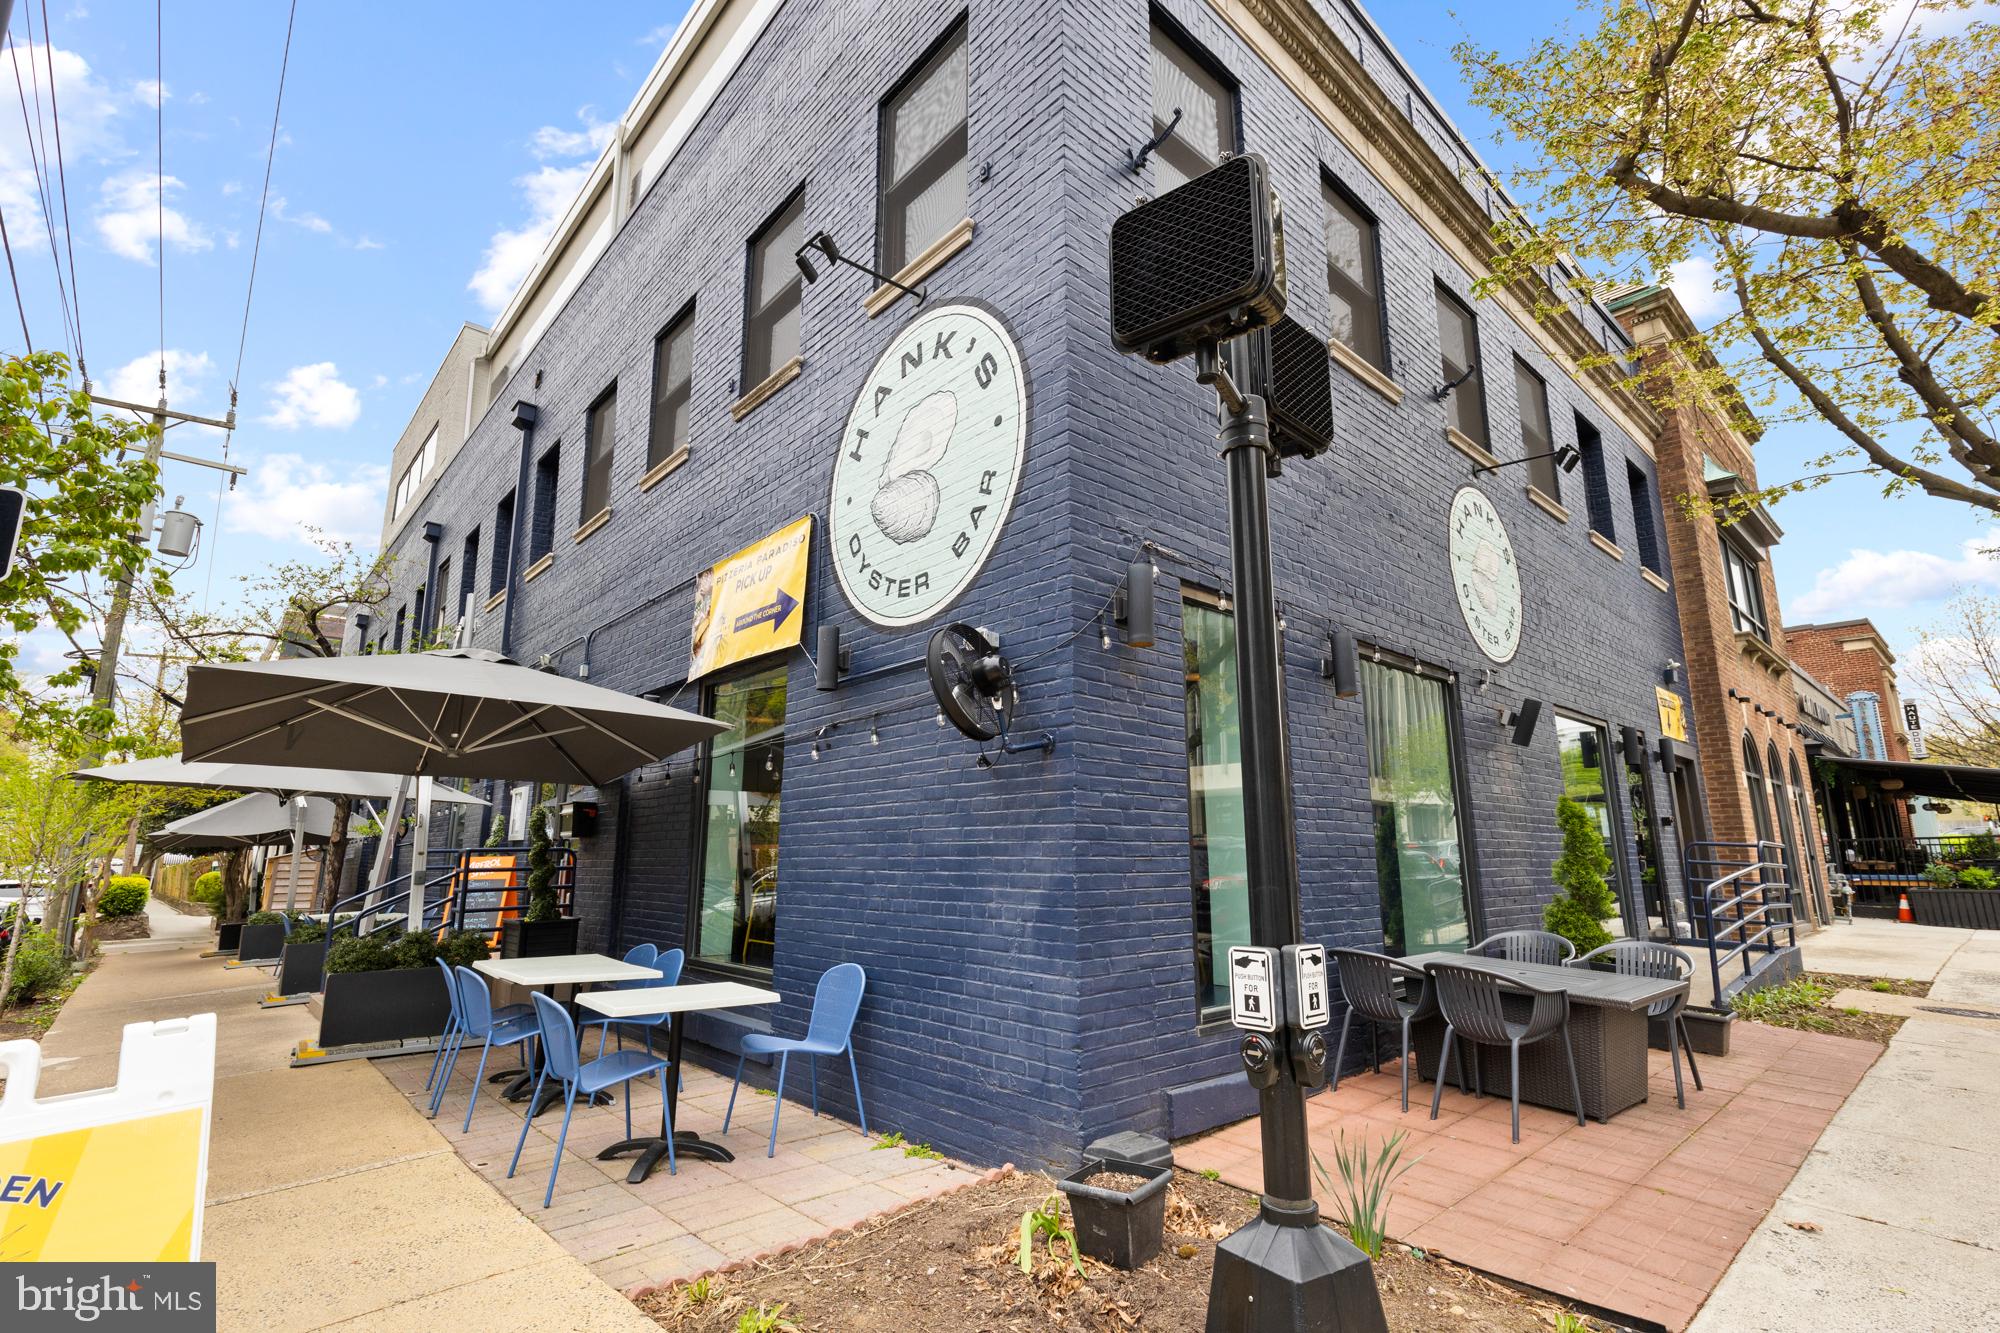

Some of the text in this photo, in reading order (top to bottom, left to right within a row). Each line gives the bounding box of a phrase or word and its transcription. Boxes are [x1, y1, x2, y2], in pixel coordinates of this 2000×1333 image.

[849, 329, 999, 462] HANK'S
[848, 468, 998, 598] OYSTER BAR
[716, 534, 806, 586] PIZZERIA PARADISO
[735, 565, 773, 593] PICK UP
[762, 604, 783, 617] CORNER
[1462, 583, 1516, 647] OYSTER BAR
[1906, 706, 1919, 730] HAUTE
[1912, 731, 1923, 753] DOGS
[1244, 984, 1259, 992] FOR
[1308, 982, 1318, 990] FOR
[0, 1174, 64, 1209] EN
